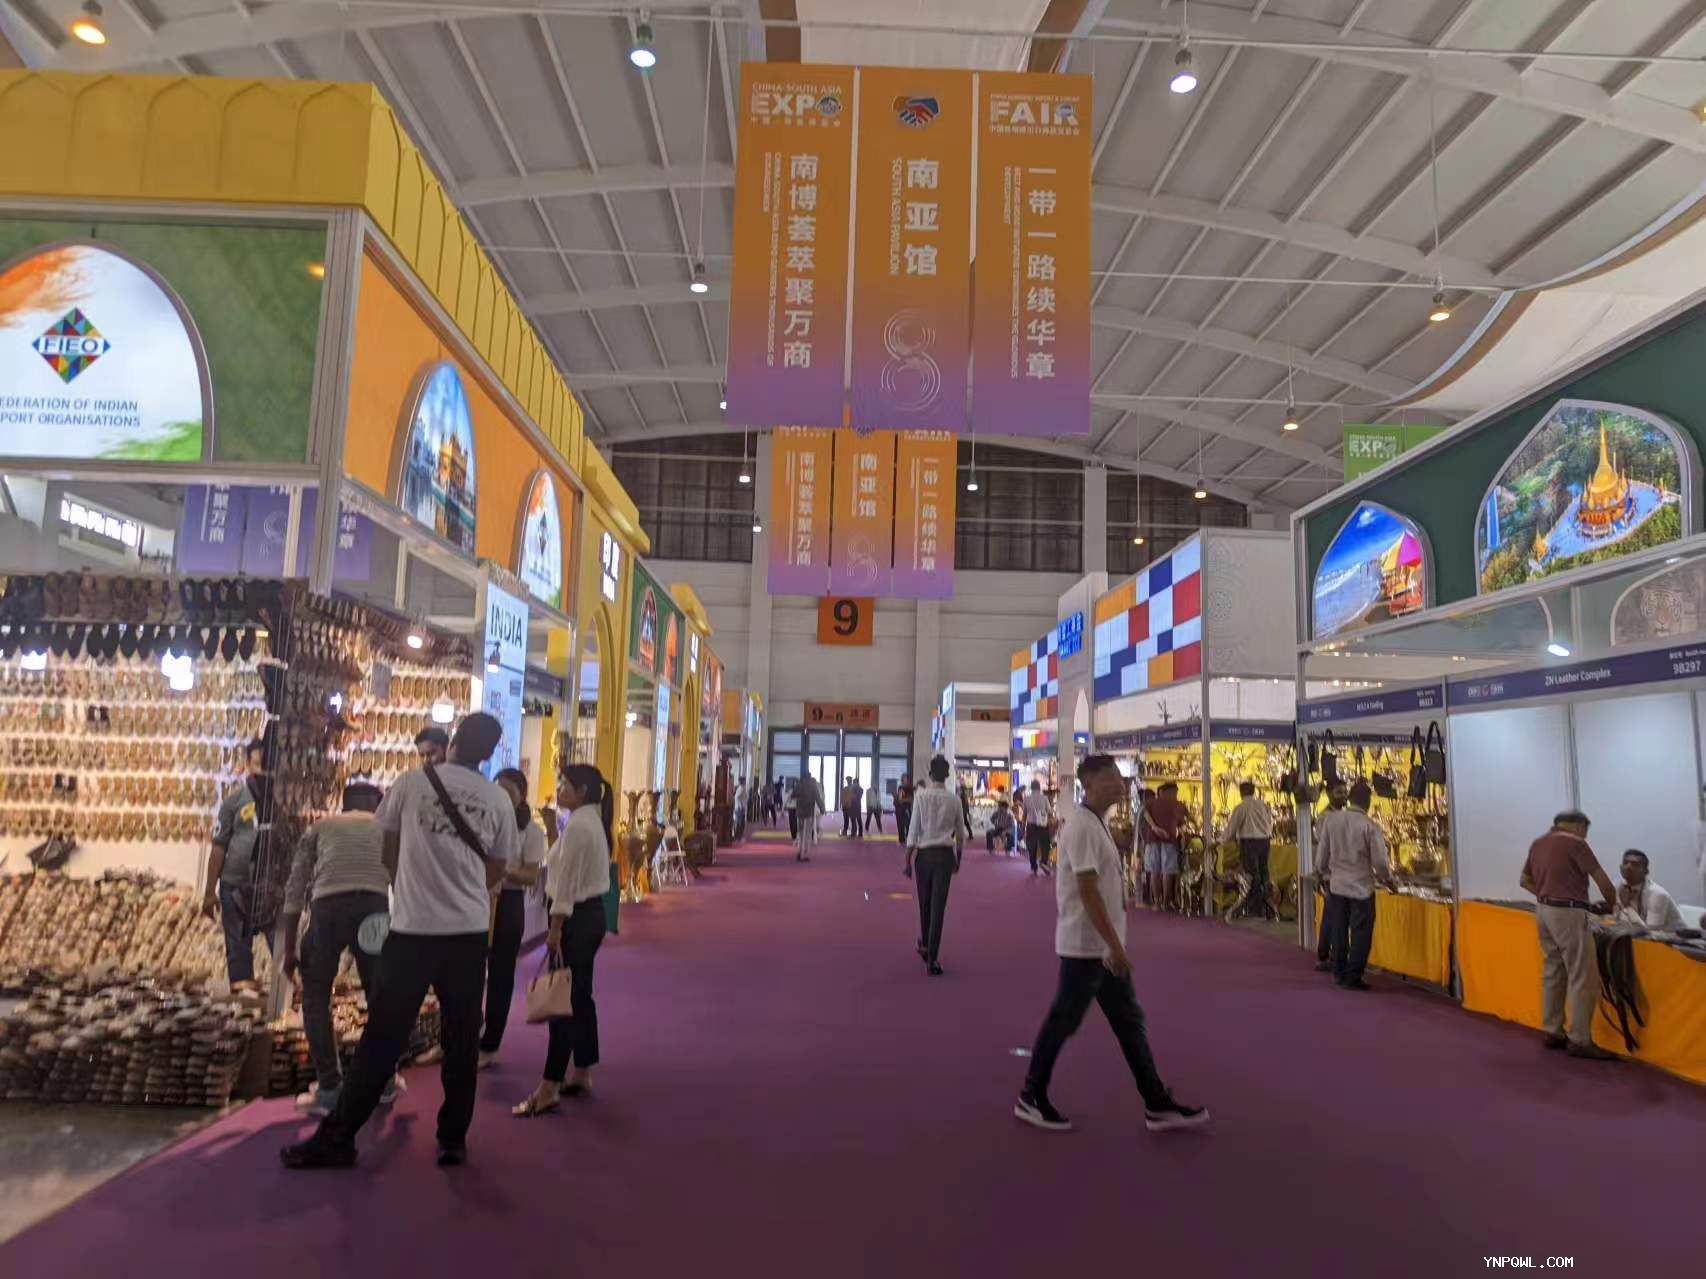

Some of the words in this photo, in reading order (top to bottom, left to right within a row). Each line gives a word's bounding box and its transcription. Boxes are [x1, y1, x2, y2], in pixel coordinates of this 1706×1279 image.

[821, 85, 841, 95] ASIA
[751, 94, 843, 116] EXPO
[991, 101, 1079, 125] FAIR
[904, 158, 939, 275] 南亚馆
[784, 153, 818, 368] 南博荟萃聚万商
[1026, 168, 1056, 379] 一带一路续华章
[43, 339, 99, 354] FIEO
[73, 399, 89, 410] OF
[94, 400, 139, 411] INDIAN
[38, 413, 141, 427] ORGANISATIONS
[491, 603, 523, 648] INDIA
[834, 600, 859, 636] 9
[1555, 671, 1580, 685] Leather
[1580, 668, 1611, 683] Complex
